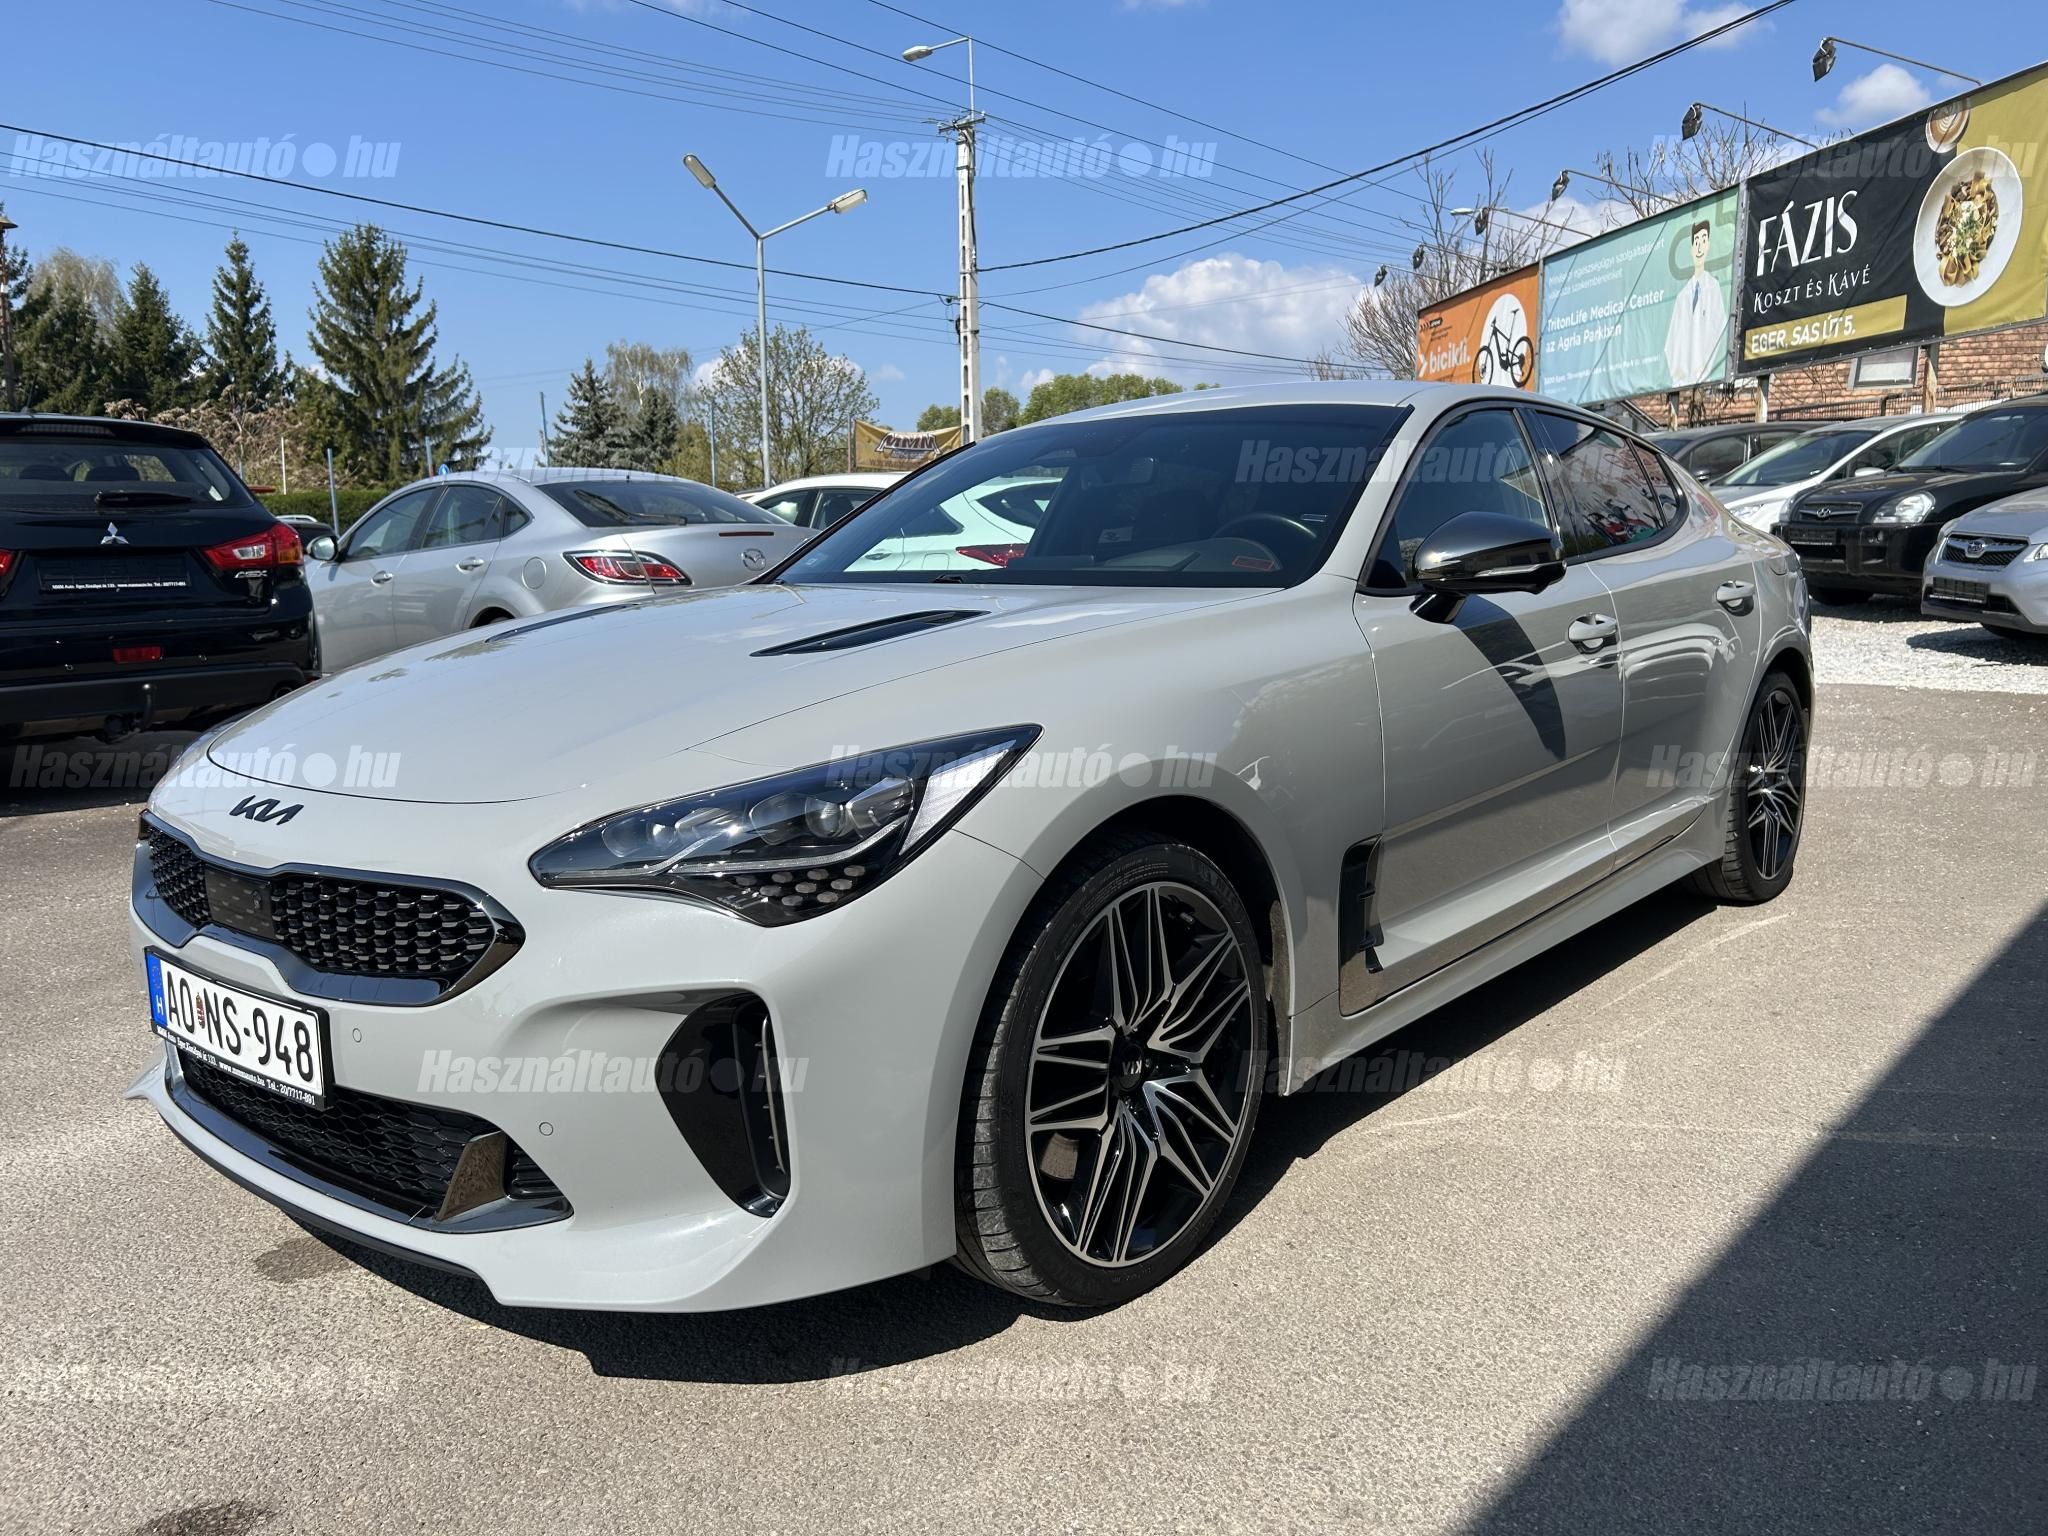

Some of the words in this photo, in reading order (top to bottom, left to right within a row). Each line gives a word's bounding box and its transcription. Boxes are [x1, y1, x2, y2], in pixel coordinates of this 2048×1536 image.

[1757, 190, 1858, 277] FÁZIS
[1547, 310, 1588, 332] TritonLife
[1590, 297, 1627, 320] Medical
[1629, 289, 1665, 310] Center
[1557, 332, 1581, 352] Agria
[1583, 323, 1622, 344] Parkban
[1791, 322, 1820, 346] SAS
[1823, 314, 1841, 338] ÚT
[234, 570, 268, 579] ASX
[156, 995, 164, 1016] H
